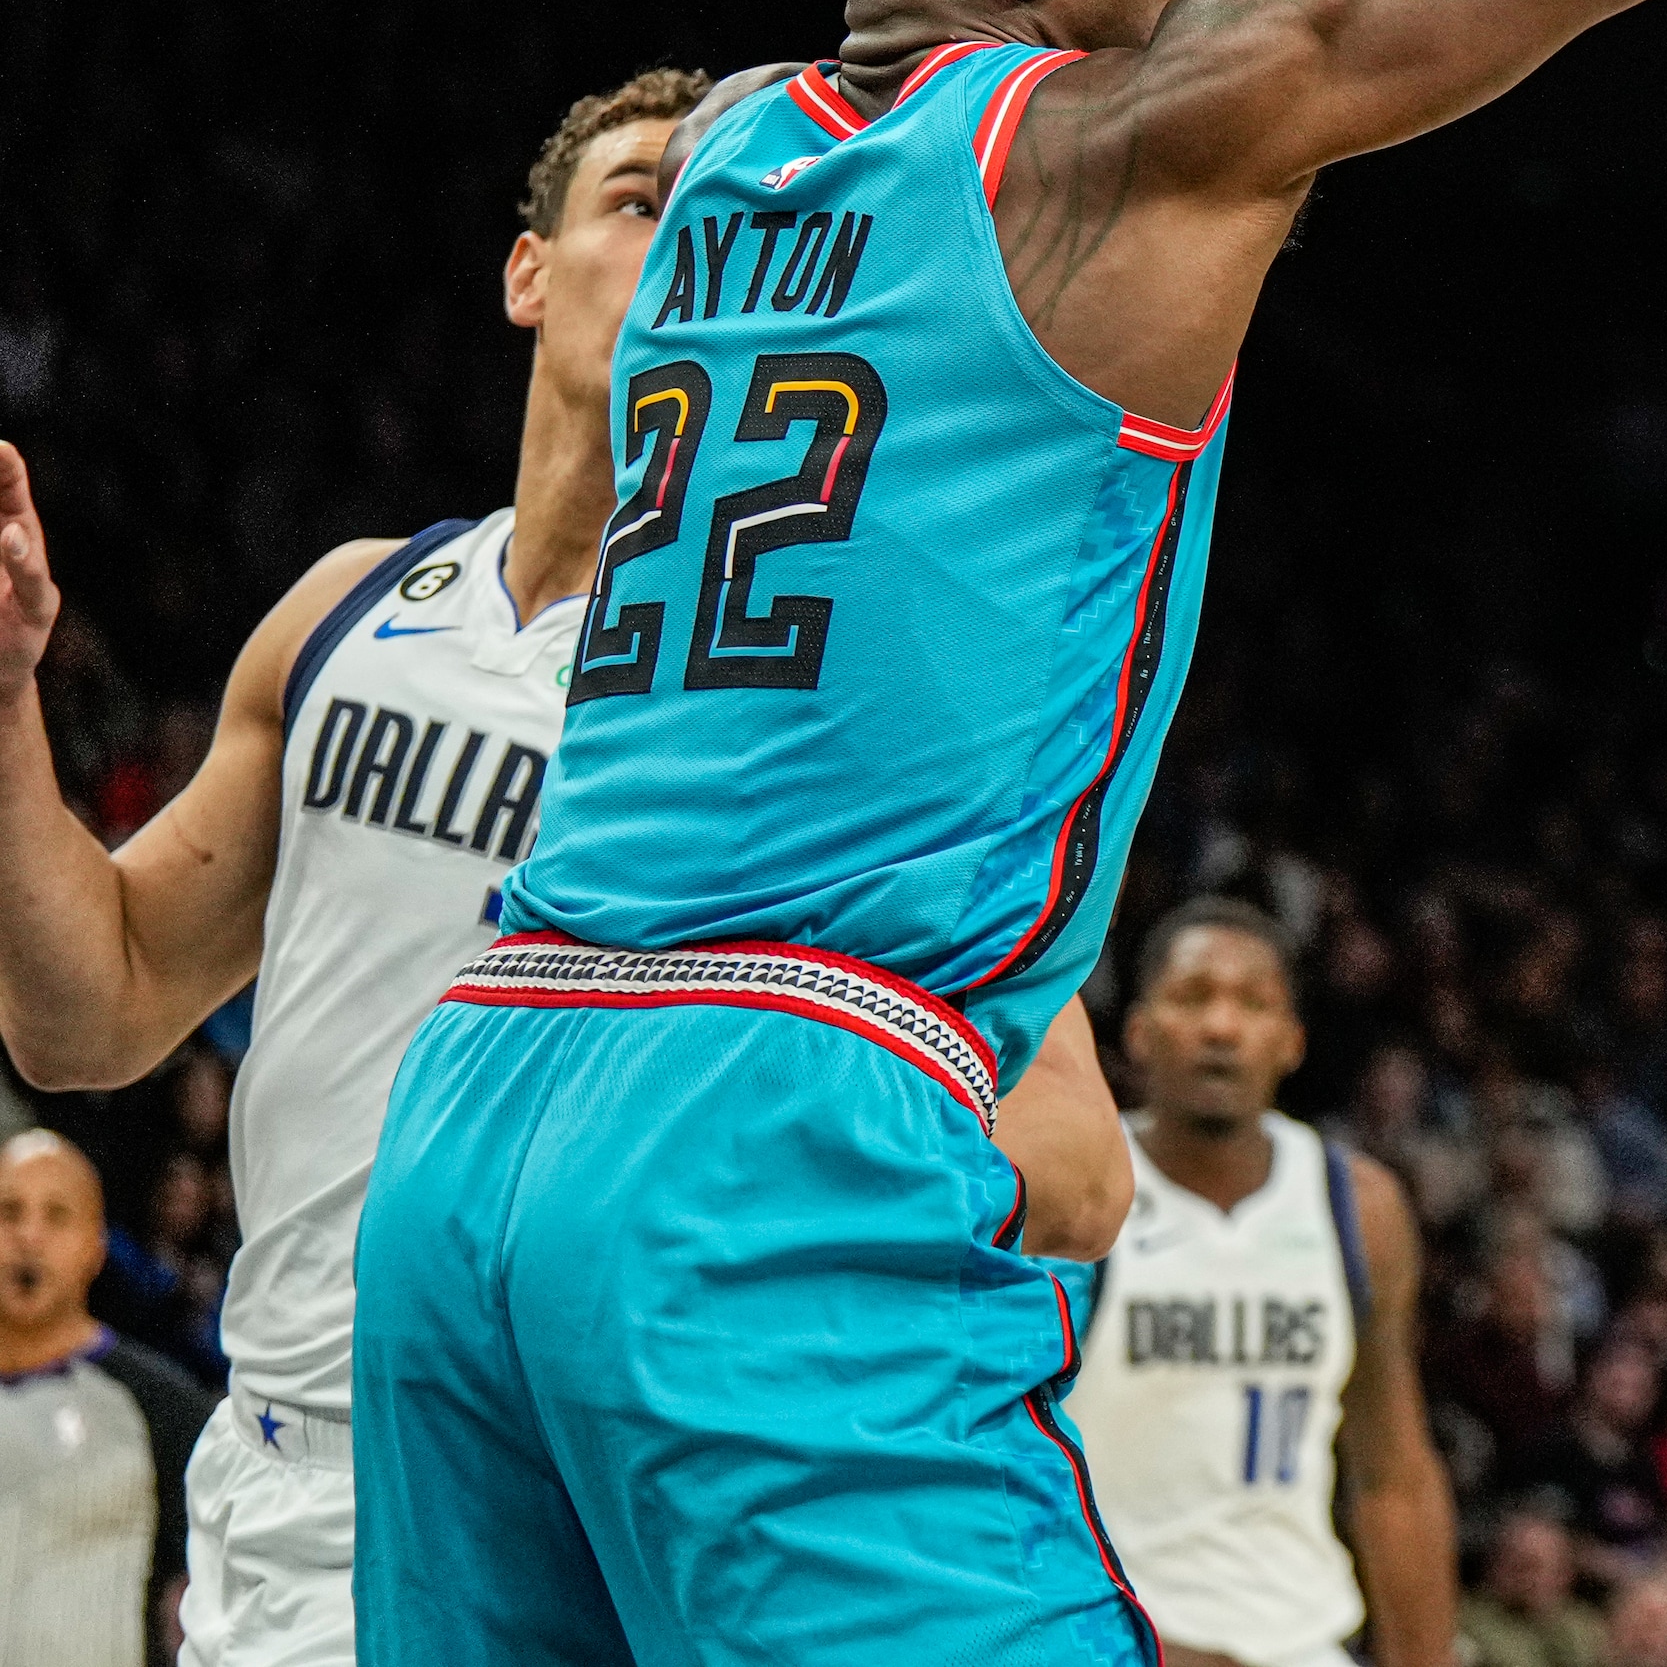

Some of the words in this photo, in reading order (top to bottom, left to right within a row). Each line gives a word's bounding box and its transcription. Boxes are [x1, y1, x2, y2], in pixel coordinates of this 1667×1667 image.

[651, 210, 874, 329] AYTON
[406, 565, 454, 599] 6
[566, 351, 889, 708] 22
[301, 697, 550, 864] DALLA
[1125, 1297, 1325, 1367] DALLAS
